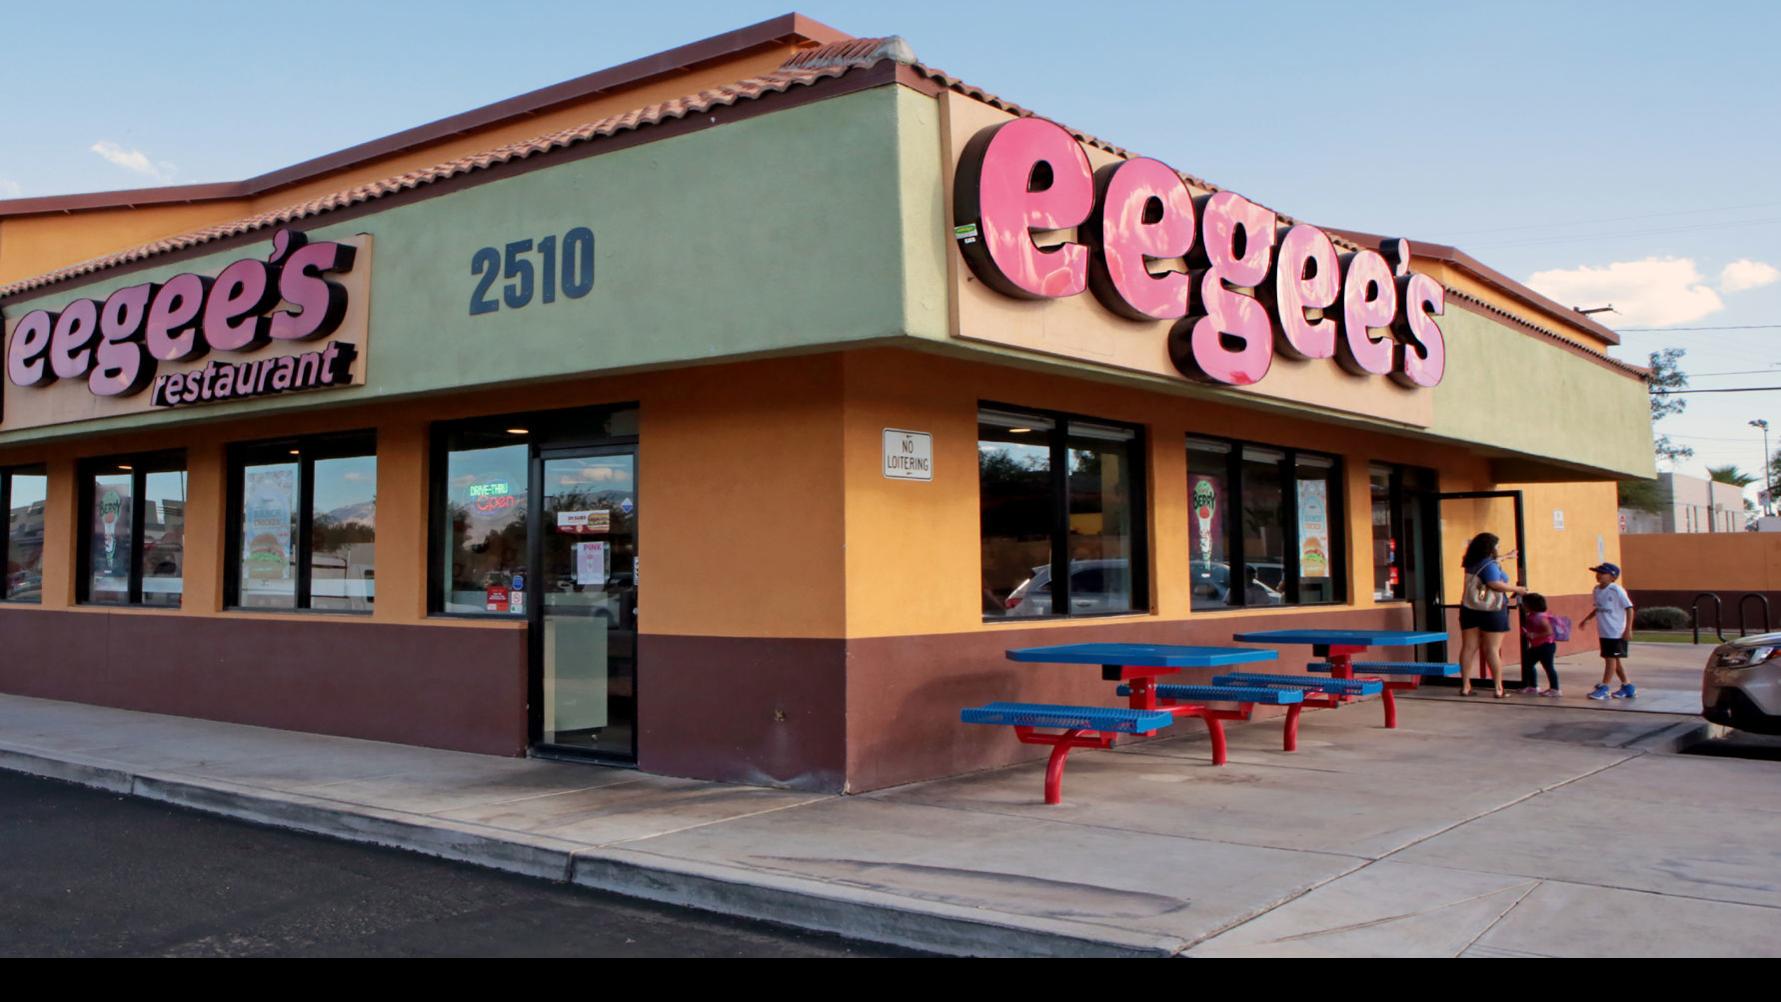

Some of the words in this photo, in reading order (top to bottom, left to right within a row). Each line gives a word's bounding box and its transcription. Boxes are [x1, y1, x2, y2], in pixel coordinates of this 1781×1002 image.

[469, 226, 595, 316] 2510
[953, 117, 1445, 387] eegee's
[8, 228, 357, 397] eegee's
[150, 341, 357, 406] restaurant
[887, 456, 929, 471] LOITERING
[902, 440, 914, 453] NO
[470, 482, 508, 497] DRIVE-THRU
